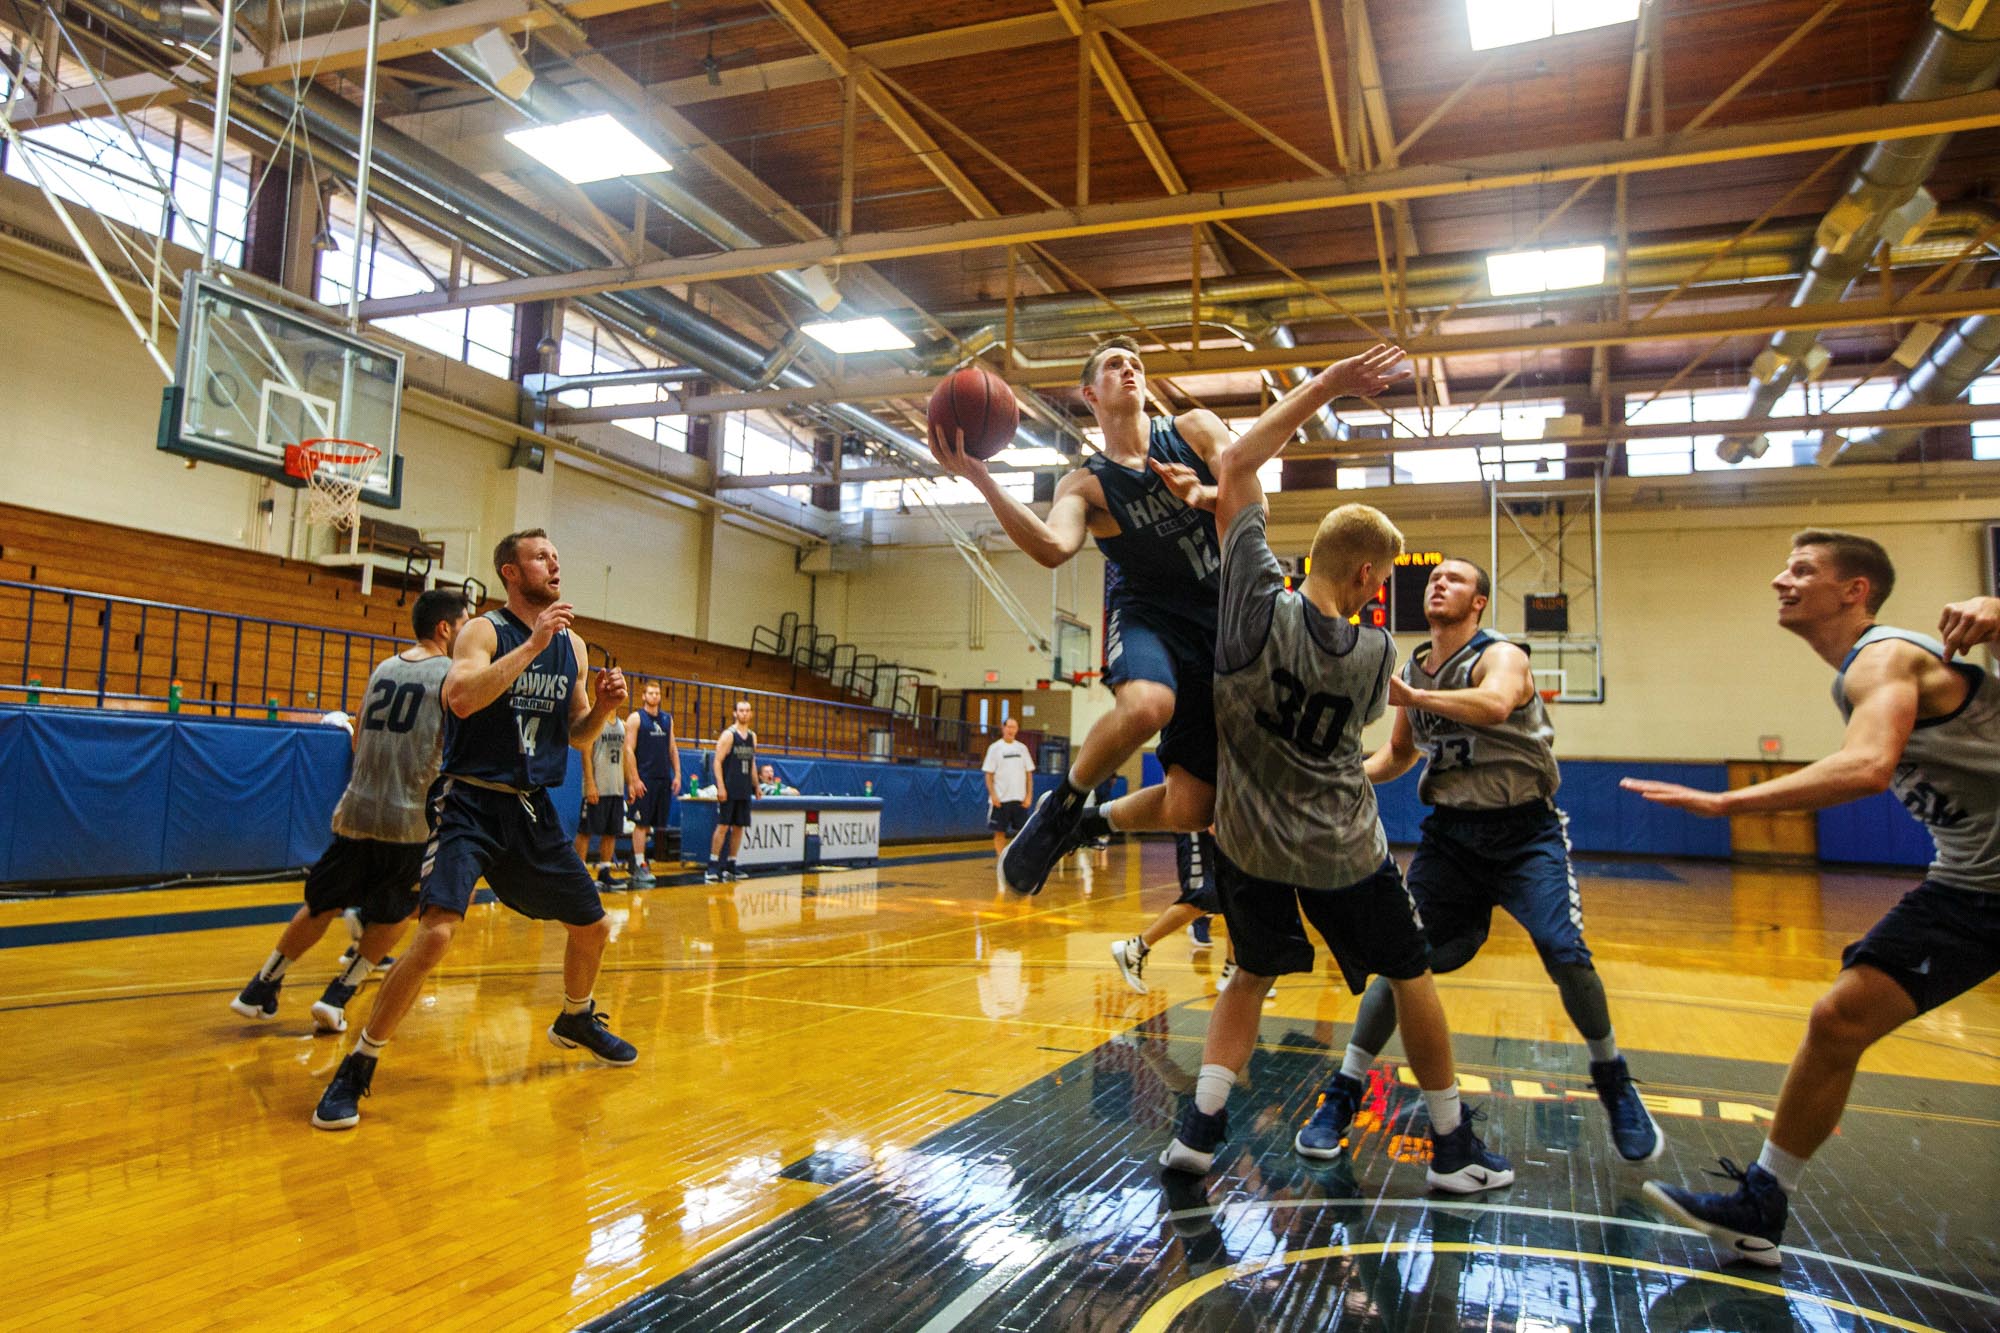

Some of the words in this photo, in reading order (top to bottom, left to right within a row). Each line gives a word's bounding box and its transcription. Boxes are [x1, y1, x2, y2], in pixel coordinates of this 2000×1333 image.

[1177, 526, 1220, 580] 12
[365, 678, 426, 734] 20
[507, 671, 569, 700] AWKS
[516, 714, 541, 757] 14
[1254, 668, 1354, 760] 30
[743, 823, 794, 850] SAINT
[820, 820, 876, 846] ANSELM
